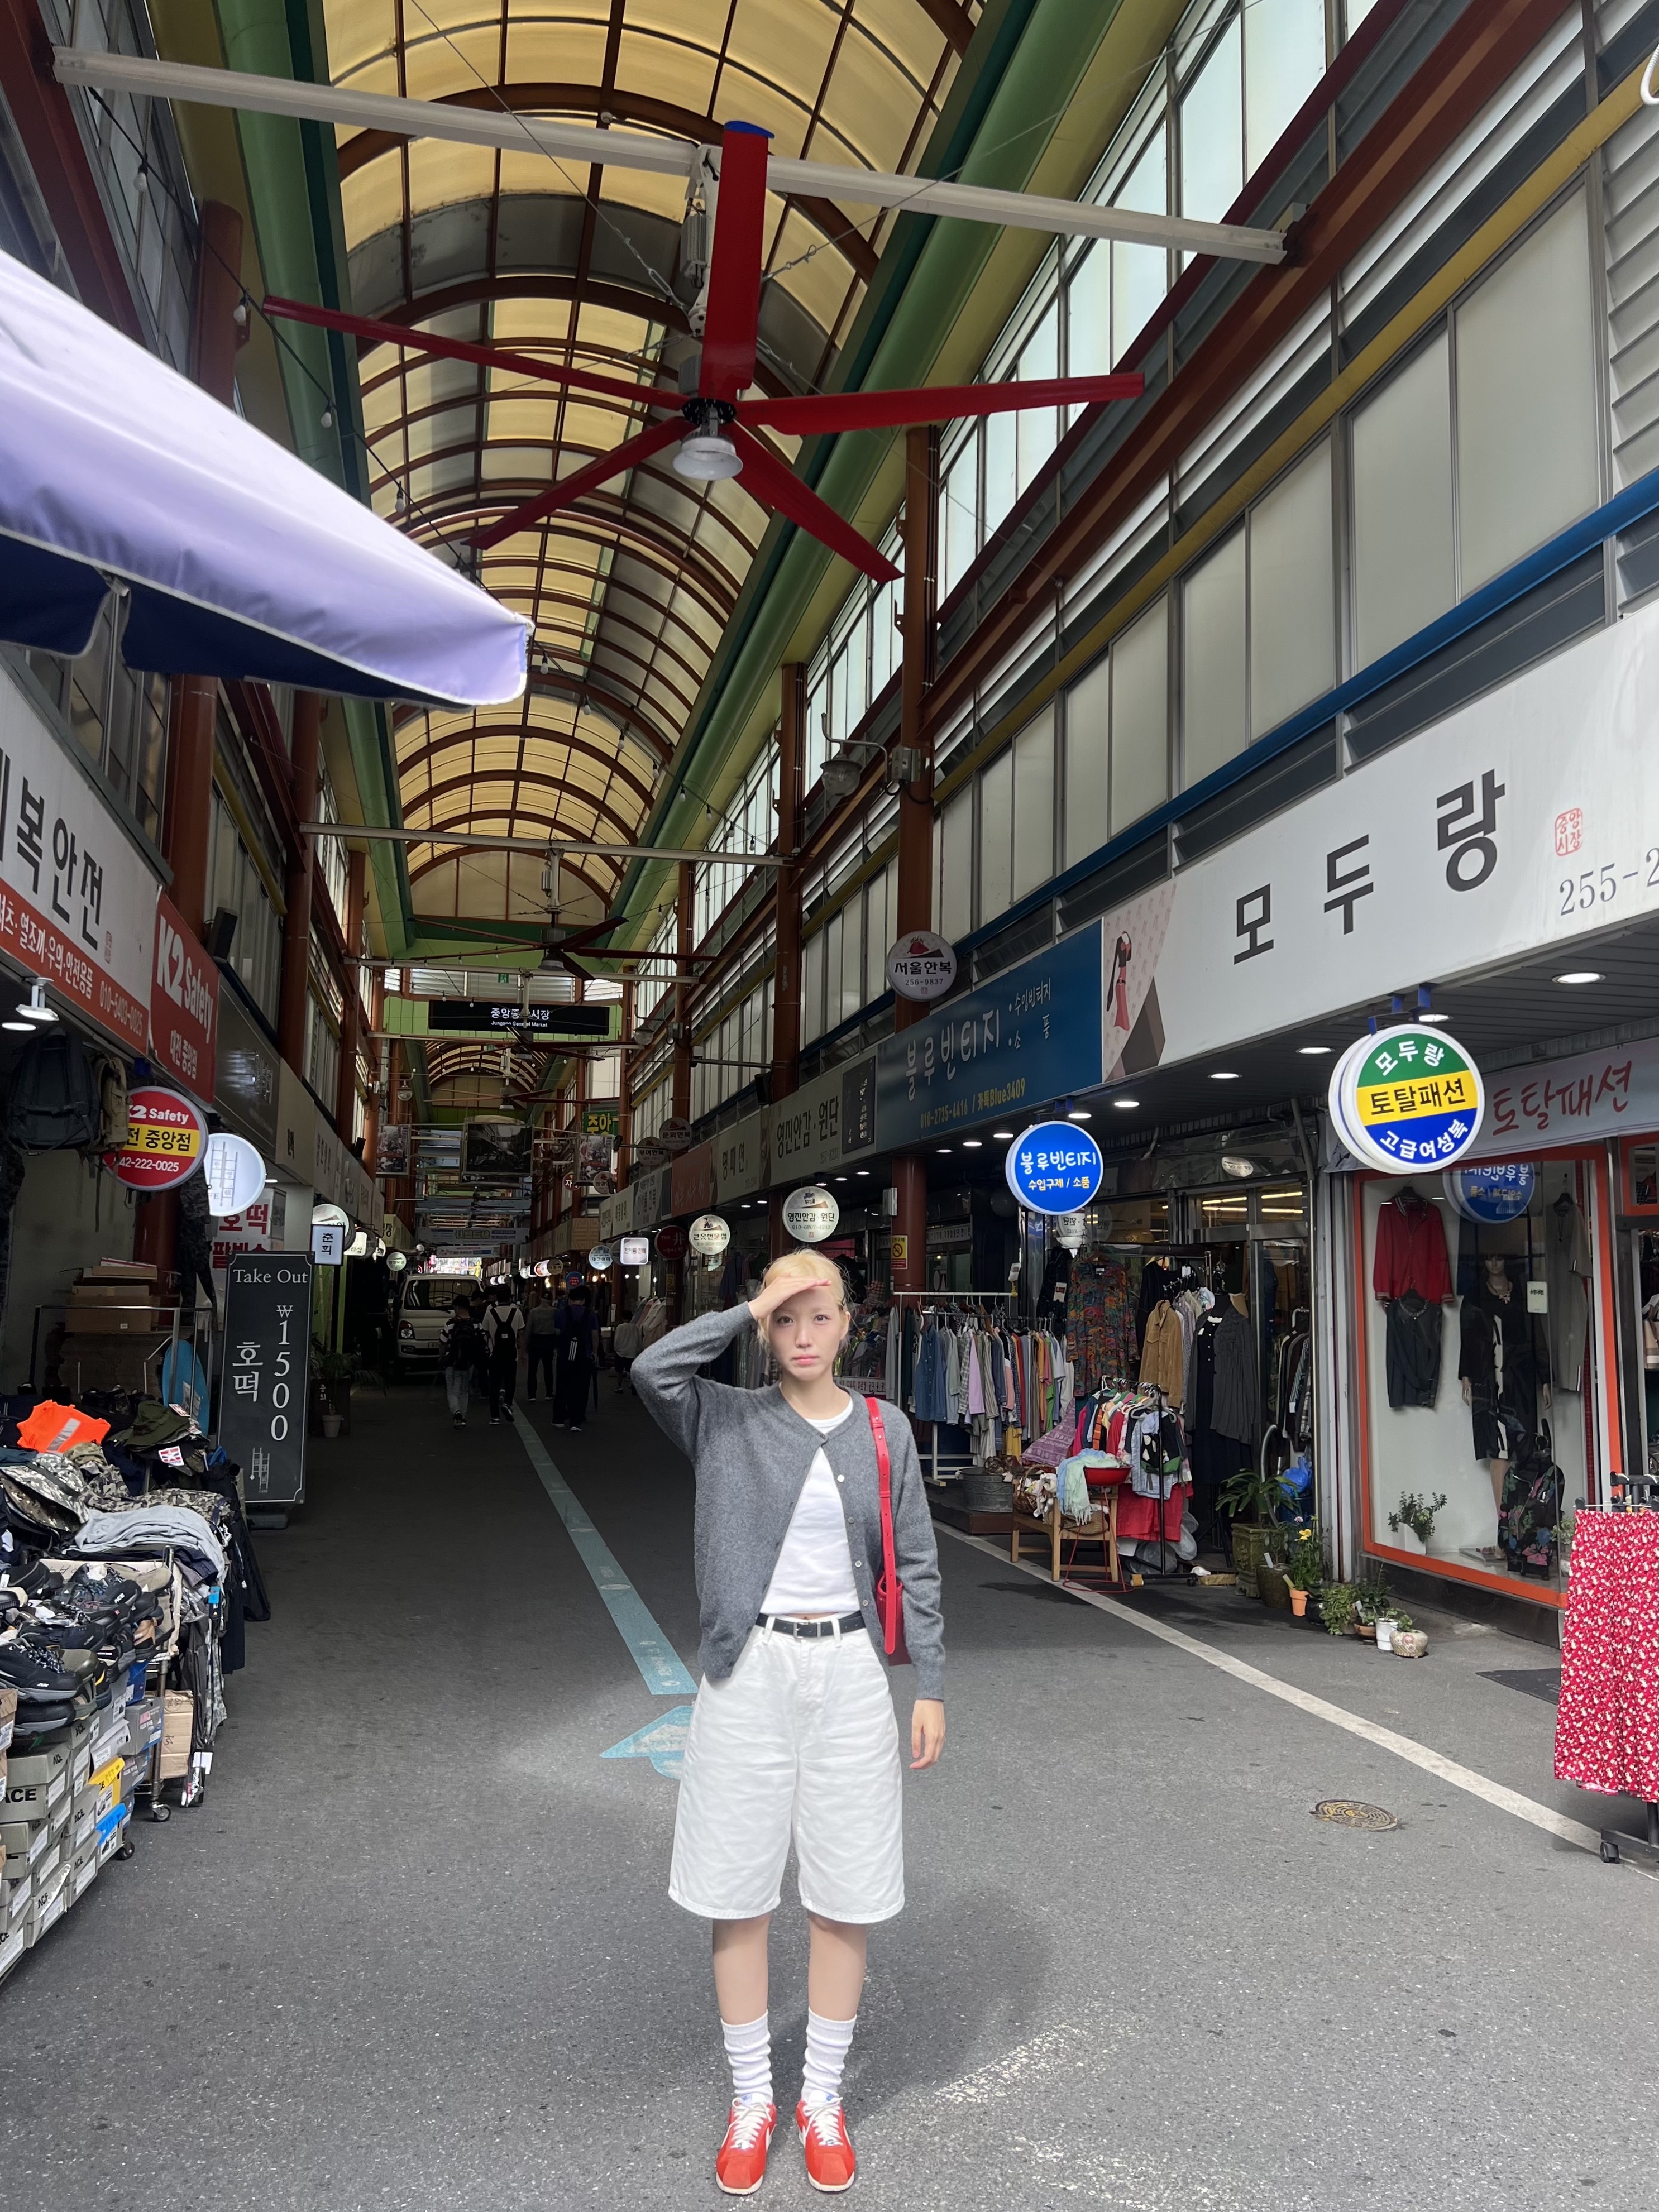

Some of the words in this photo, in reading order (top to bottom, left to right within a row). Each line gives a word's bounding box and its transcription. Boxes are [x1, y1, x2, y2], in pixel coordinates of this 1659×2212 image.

[1557, 811, 1581, 834] 중앙
[1557, 829, 1581, 854] 시장
[1234, 768, 1505, 965] 모두랑
[895, 961, 952, 975] 서울한복
[157, 914, 184, 1008] K2
[184, 957, 213, 1043] Safety
[490, 1008, 550, 1021] 중앙종시장
[906, 1009, 1000, 1101] 블루빈티지
[1375, 1041, 1445, 1076] 모두랑
[1370, 1078, 1466, 1115] 토탈패션
[1493, 1060, 1632, 1136] 토탈패션
[149, 1108, 189, 1125] Safety
[126, 1128, 140, 1146] 전
[145, 1129, 191, 1152] 중앙점
[1380, 1119, 1469, 1160] 고급여성복
[113, 1156, 179, 1173] 42-222-0025
[1020, 1150, 1096, 1175] 블루빈티지
[1028, 1177, 1064, 1191] 수입구제
[1072, 1176, 1090, 1189] 소품
[787, 1213, 816, 1222] 영진안감
[821, 1213, 835, 1222] 원단
[233, 1268, 271, 1284] Take
[276, 1268, 309, 1284] Out
[232, 1341, 264, 1402] 호떡
[114, 1593, 126, 1604] ACE
[75, 1723, 85, 1737] ACE
[74, 1809, 85, 1823] ACE
[74, 1856, 84, 1870] ACE
[0, 1932, 9, 1945] CE
